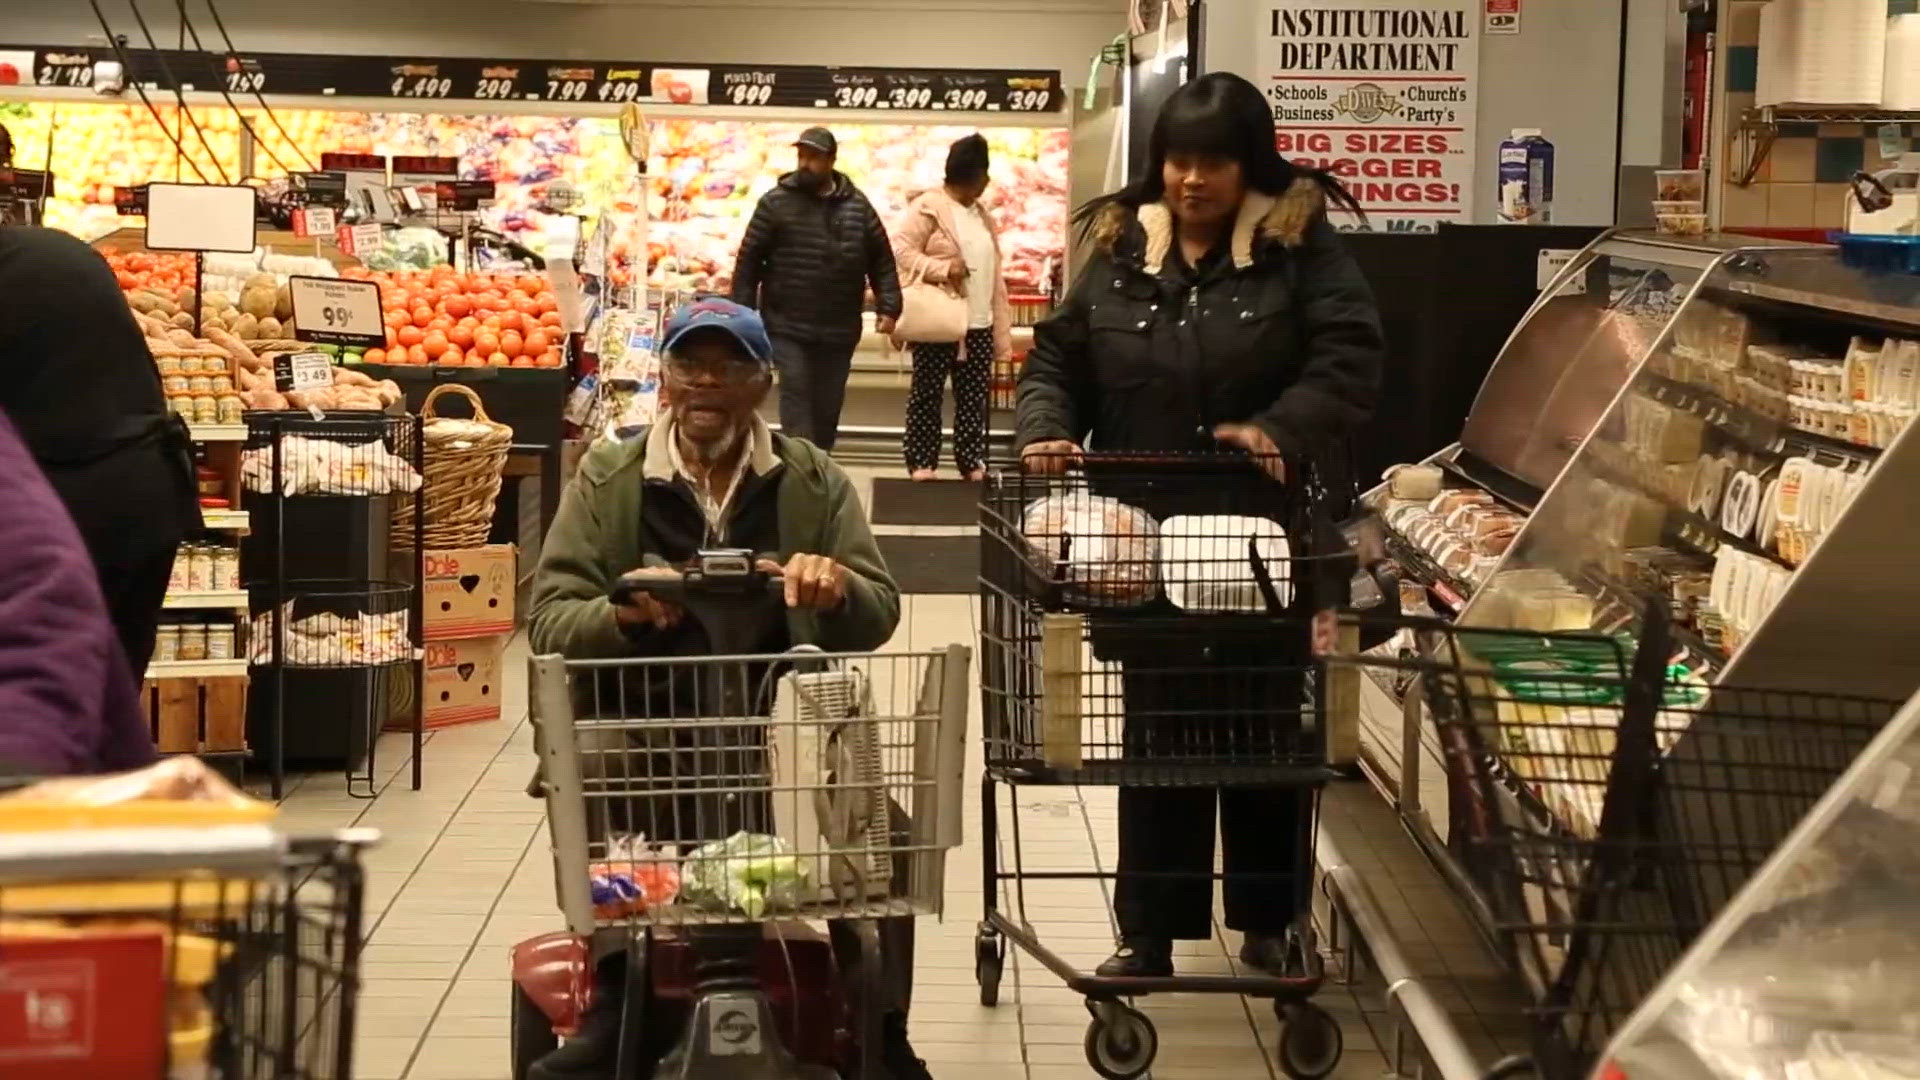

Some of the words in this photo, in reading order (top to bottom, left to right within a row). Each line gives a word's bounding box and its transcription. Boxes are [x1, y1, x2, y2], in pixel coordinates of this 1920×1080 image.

[1271, 9, 1469, 38] INSTITUTIONAL
[1280, 42, 1458, 71] DEPARTMENT
[547, 81, 588, 100] 7.99
[1275, 85, 1328, 100] Schools
[1407, 86, 1467, 102] Church's
[1273, 105, 1334, 121] Business
[1407, 107, 1455, 126] Party's
[1275, 133, 1332, 153] BIG
[425, 554, 459, 576] Dole
[426, 644, 456, 666] Dole
